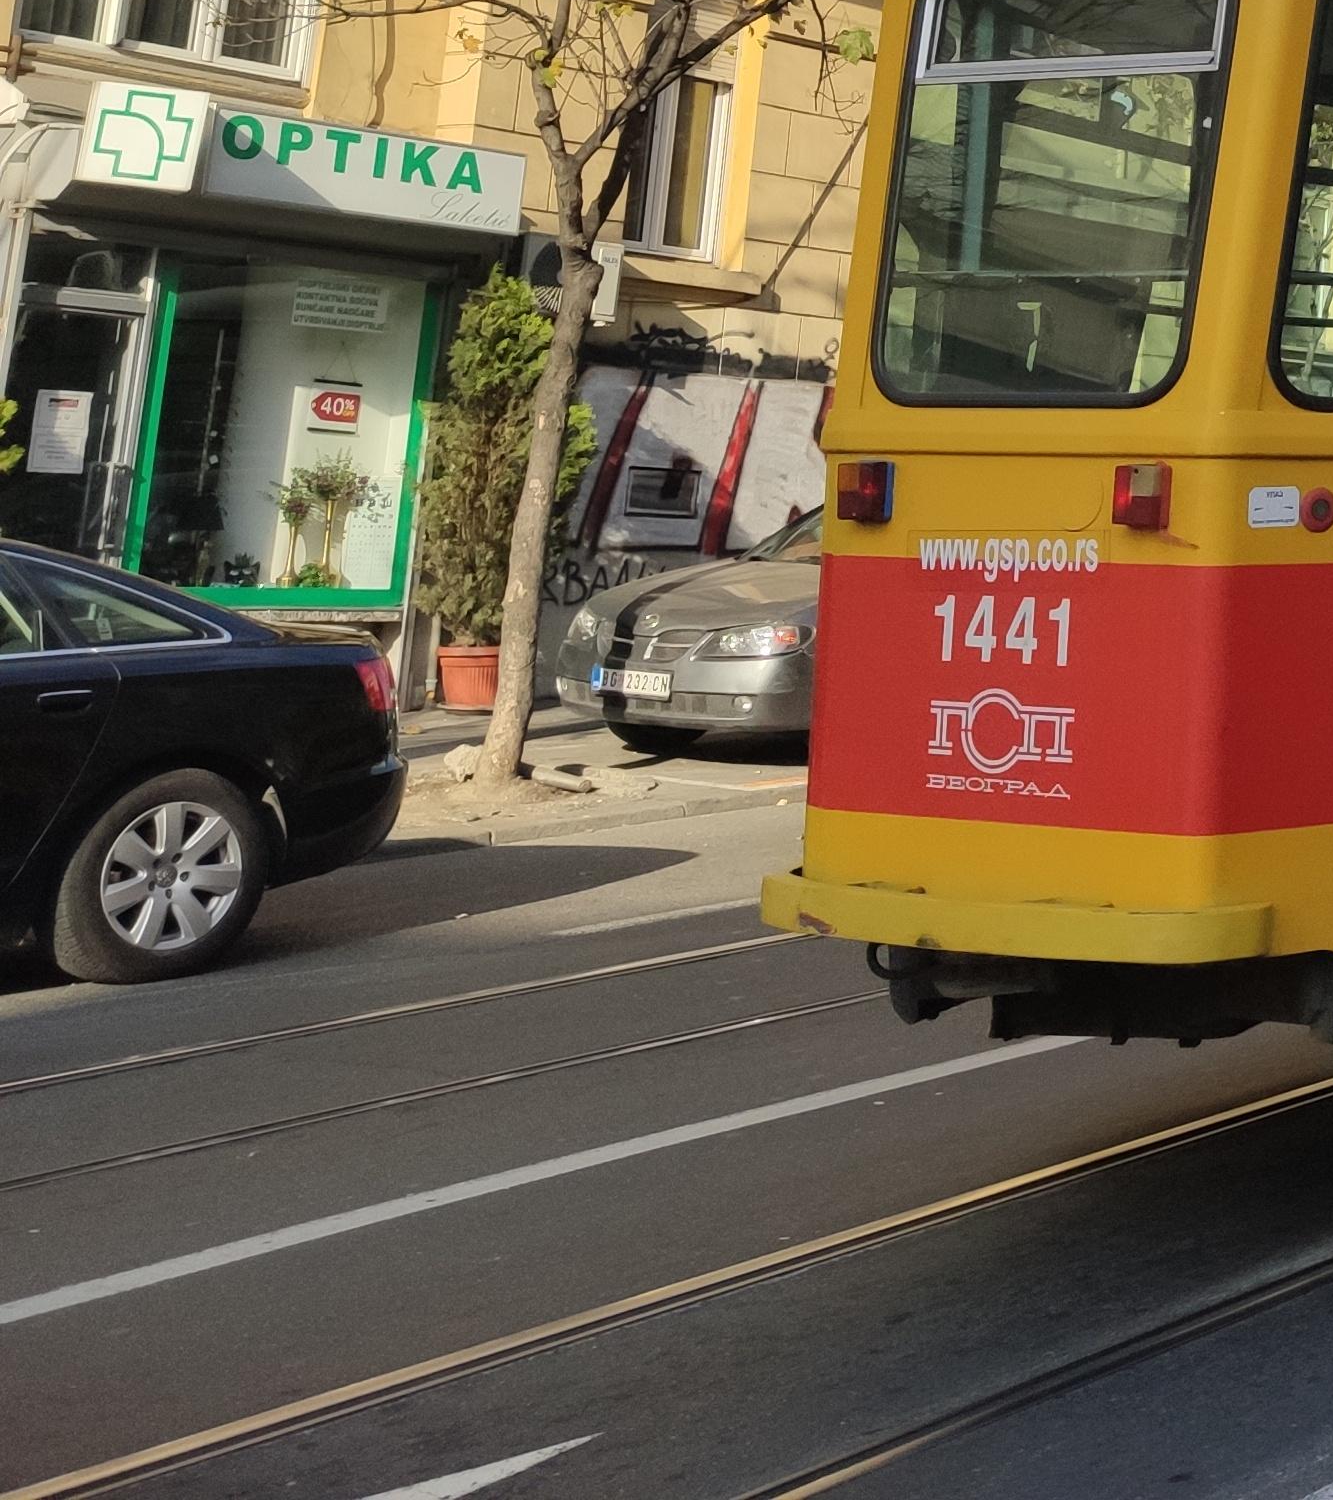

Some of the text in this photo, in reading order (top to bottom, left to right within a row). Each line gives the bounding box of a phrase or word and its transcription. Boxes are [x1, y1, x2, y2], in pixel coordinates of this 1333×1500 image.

[222, 115, 482, 194] OPTIKA
[321, 397, 354, 415] 40%
[920, 538, 1099, 583] www.gsp.co.rs
[934, 594, 1071, 667] 1441
[602, 671, 617, 687] BG
